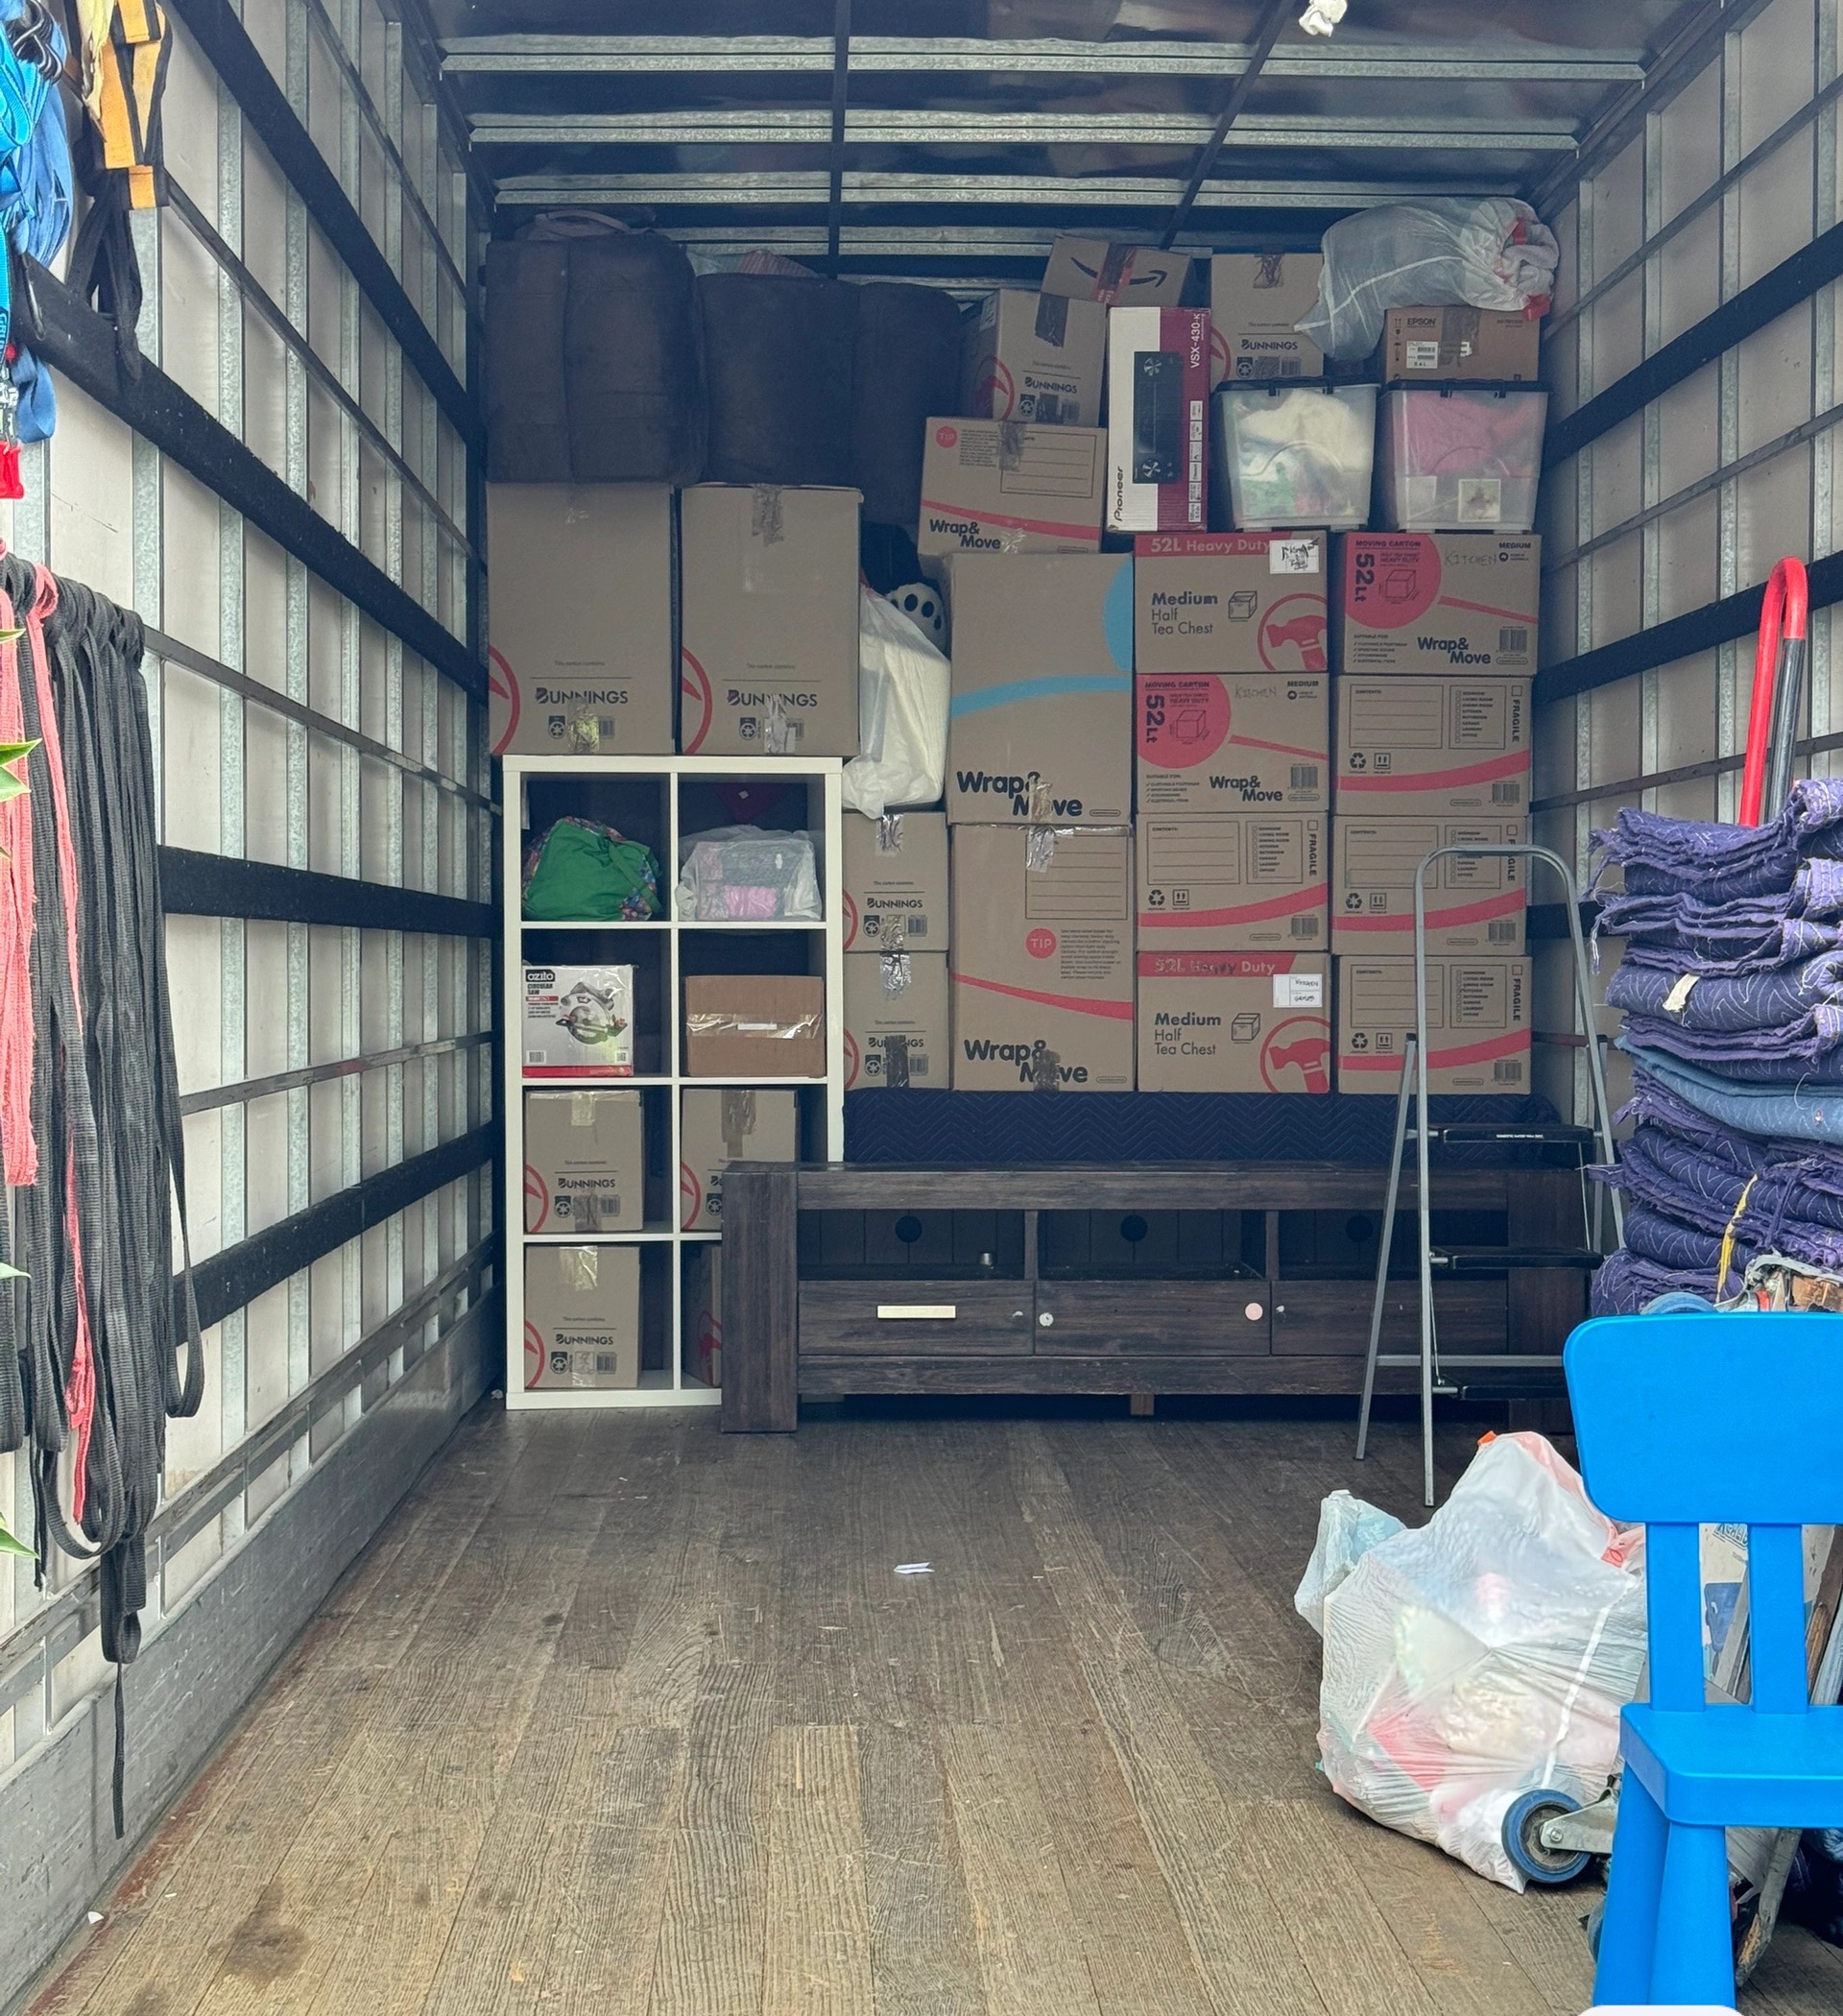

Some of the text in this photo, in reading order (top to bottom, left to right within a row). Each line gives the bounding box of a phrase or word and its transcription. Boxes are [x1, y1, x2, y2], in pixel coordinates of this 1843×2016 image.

[1190, 313, 1201, 369] VSX-430-K
[1241, 339, 1298, 350] BUNNINGS
[1024, 376, 1078, 394] BUNNINGS
[1113, 466, 1123, 522] Pioneer
[929, 518, 980, 538] Wrap&
[960, 535, 1001, 550] Move
[1151, 538, 1270, 554] 52L Heavy Duty
[1151, 590, 1218, 606] Medium
[1151, 608, 1179, 622] Half
[1151, 622, 1214, 635] Tea Chest
[1417, 636, 1470, 653] Wrap&
[1449, 651, 1491, 664] Move
[1512, 699, 1520, 743] FRAGILE
[1209, 775, 1261, 792] Wrap&
[1241, 788, 1282, 802] Move
[1013, 795, 1083, 816] Mve
[1309, 833, 1318, 876] FRAGILE
[1507, 838, 1516, 881] FGILE
[867, 898, 923, 908] BUNNINGS
[1030, 938, 1052, 948] TIP
[1155, 957, 1185, 972] 52L
[1241, 960, 1276, 974] Duty
[1513, 978, 1521, 1021] FRAGILE
[1155, 1012, 1221, 1026] Medium
[1155, 1027, 1182, 1042] Half
[1155, 1043, 1216, 1055] Tea Chest
[1019, 1062, 1089, 1083] Mve
[558, 1178, 615, 1188] BUNNINGS
[556, 1333, 613, 1345] BUNNINGS
